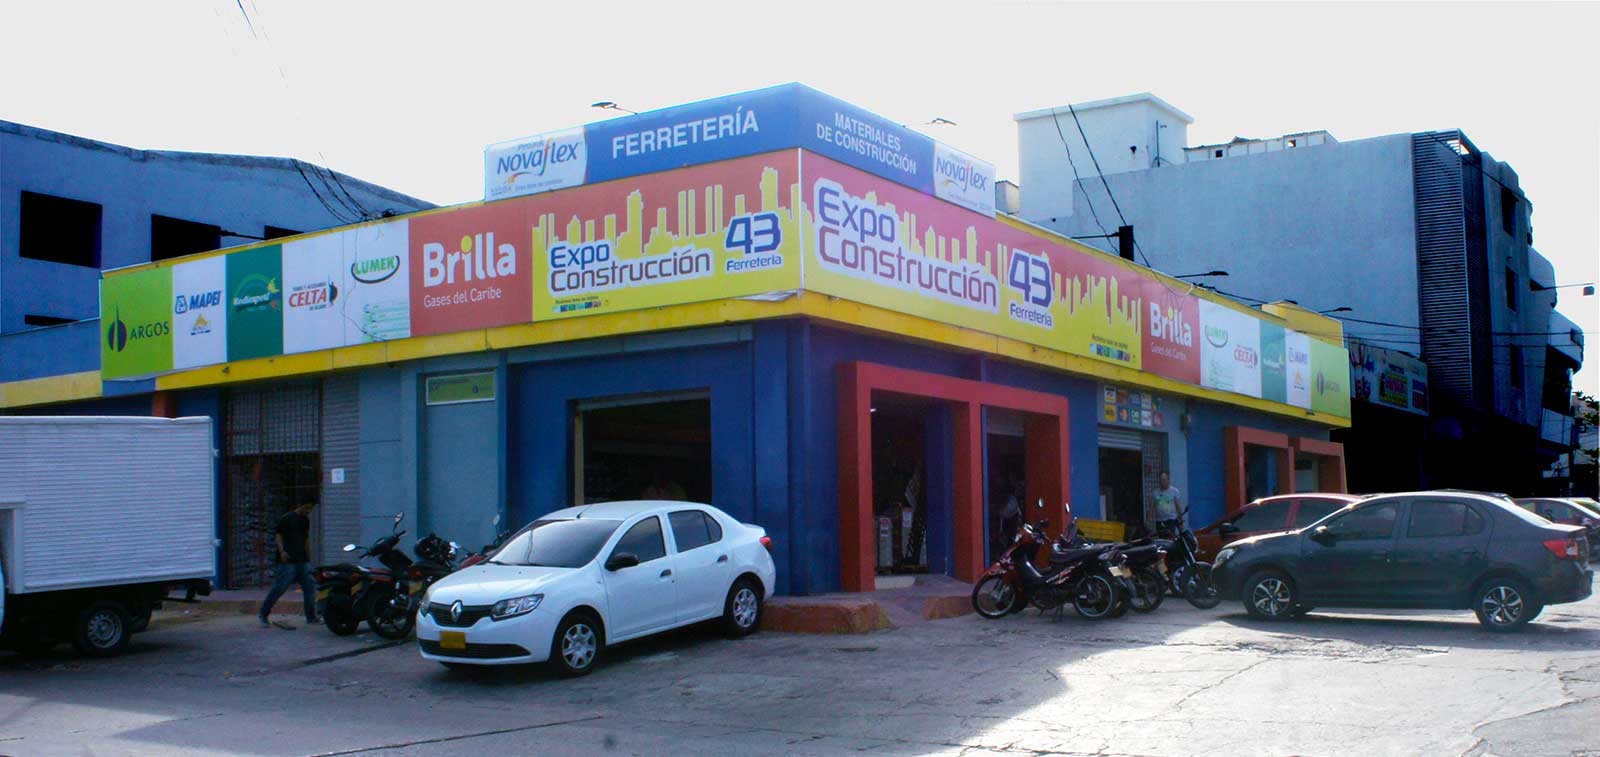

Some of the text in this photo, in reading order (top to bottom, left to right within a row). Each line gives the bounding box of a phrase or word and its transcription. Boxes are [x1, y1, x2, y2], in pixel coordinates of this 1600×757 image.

[612, 106, 759, 159] FERRETERÍA
[816, 123, 833, 143] DE
[834, 130, 917, 175] CONSTRUCCIÓN
[834, 112, 901, 151] MATERIALES
[725, 212, 781, 255] 43
[819, 186, 895, 242] Expo
[423, 232, 516, 288] Brilla
[550, 243, 610, 270] Expo
[550, 250, 711, 292] Construcción
[819, 226, 998, 306] Construcción
[190, 290, 223, 310] MAPEI
[288, 288, 327, 308] CELTA
[424, 286, 502, 308] Gases del Caribe
[1010, 252, 1051, 308] 43
[130, 320, 170, 341] ARGOS
[1150, 302, 1193, 347] Brilla
